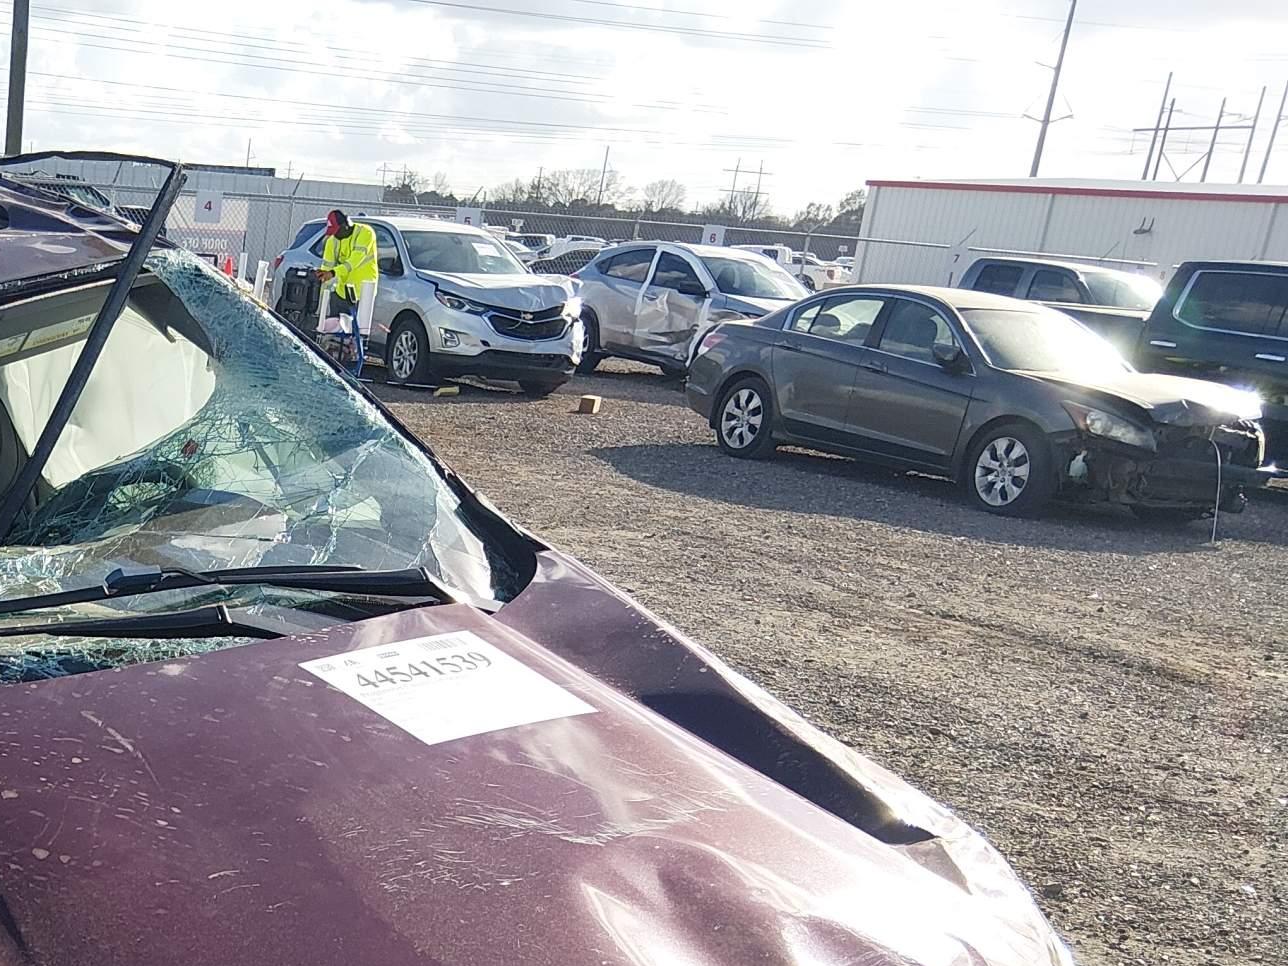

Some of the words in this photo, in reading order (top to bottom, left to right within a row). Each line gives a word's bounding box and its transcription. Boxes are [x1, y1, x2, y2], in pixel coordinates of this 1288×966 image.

[203, 200, 212, 211] 4
[709, 233, 717, 243] 6
[953, 253, 961, 263] 7
[1159, 270, 1166, 280] 8
[356, 651, 492, 688] 44541539
